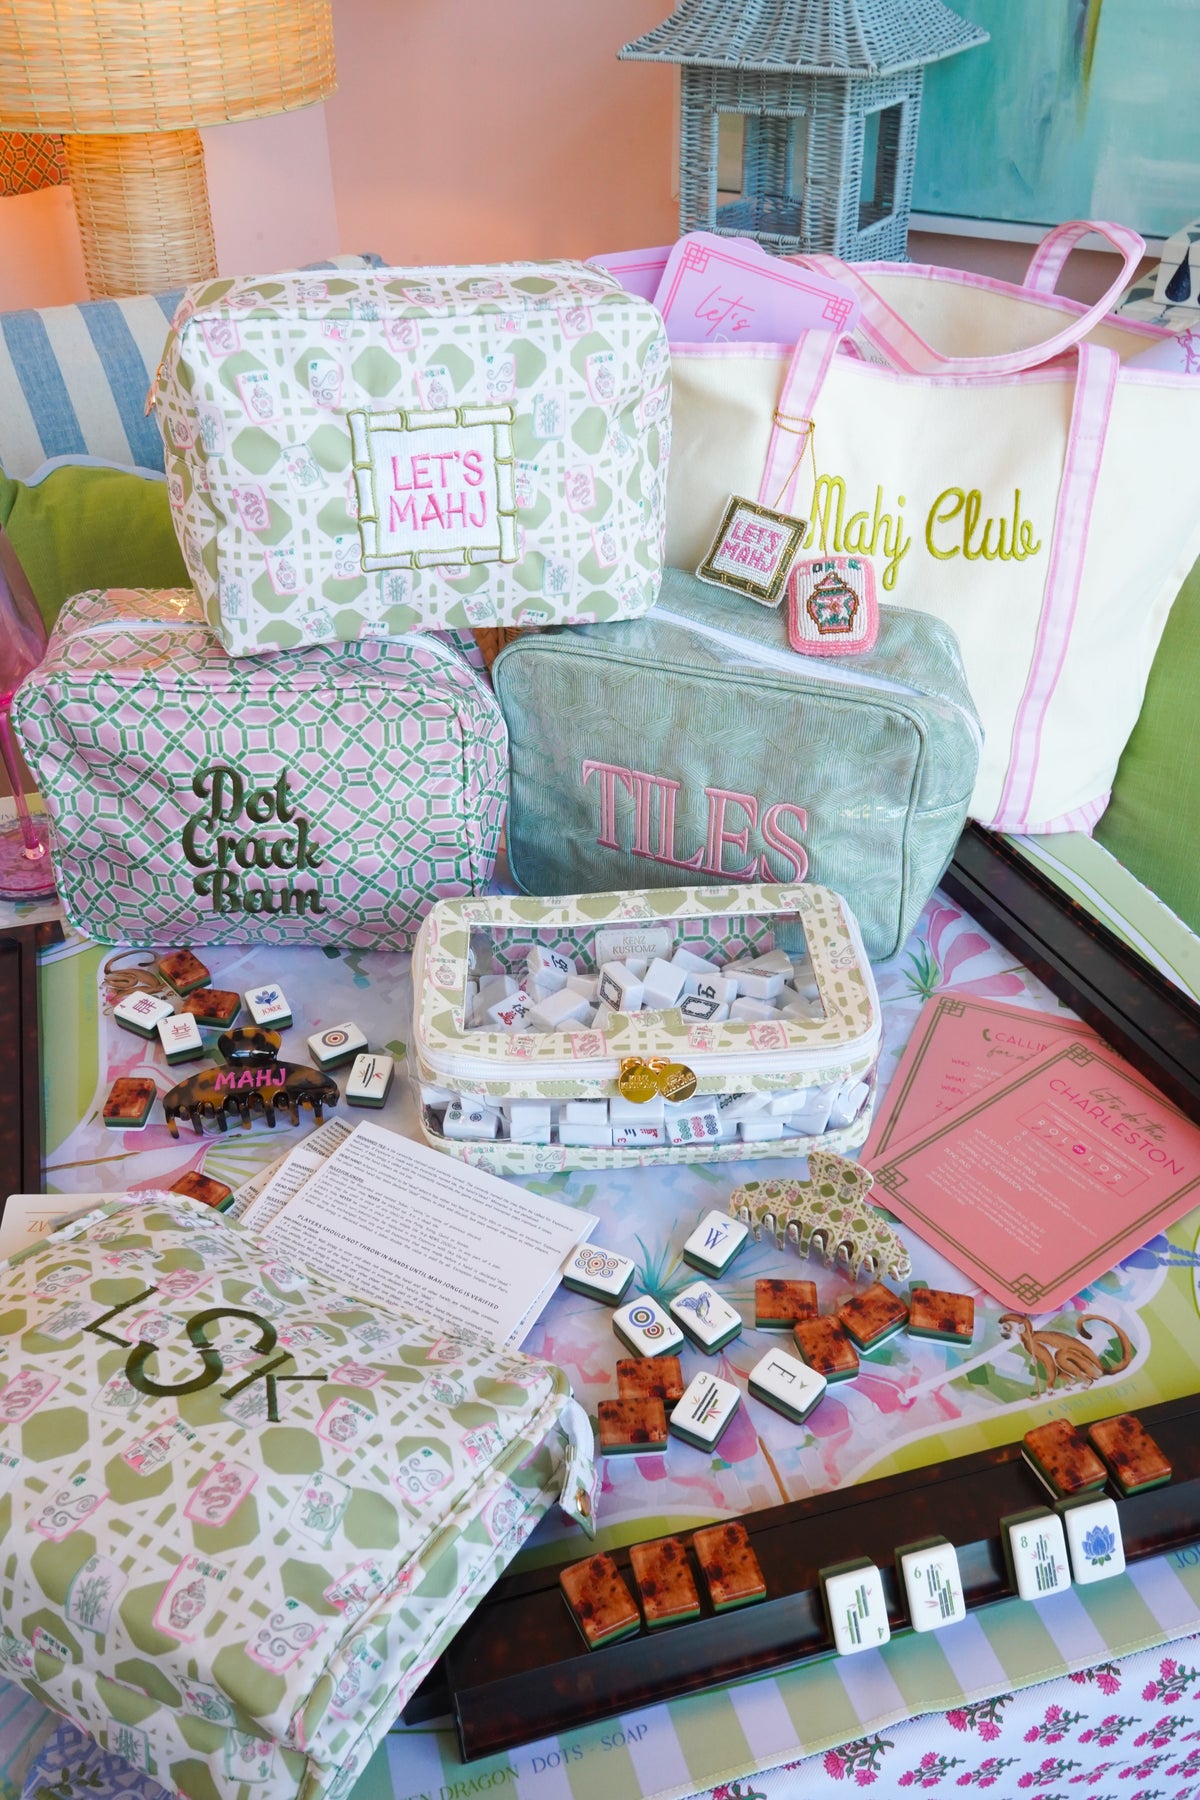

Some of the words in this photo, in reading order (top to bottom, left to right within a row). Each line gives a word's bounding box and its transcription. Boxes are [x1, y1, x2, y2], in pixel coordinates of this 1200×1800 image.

[694, 285, 756, 337] let's
[391, 450, 485, 491] LET'S
[389, 491, 487, 533] MAHJ
[731, 520, 783, 554] LET'S
[802, 474, 912, 592] Mahj
[926, 487, 1042, 561] Club
[720, 540, 777, 574] MAHJ
[192, 765, 296, 823] Dot
[582, 759, 809, 884] TILES
[182, 815, 324, 870] Crack
[193, 869, 328, 915] Bam
[612, 944, 656, 955] KUSTOMZ
[622, 935, 647, 945] KENZ
[262, 1004, 282, 1016] JOKER
[214, 1068, 287, 1092] MAHJ
[1049, 1079, 1185, 1177] CHARLESTON
[703, 1226, 729, 1250] W
[296, 1214, 322, 1228] PLAYERS
[321, 1226, 346, 1239] SHOULD
[345, 1236, 358, 1245] NOT
[358, 1243, 381, 1256] THROW
[387, 1256, 409, 1268] HANDS
[408, 1266, 427, 1277] UNTIL
[427, 1274, 442, 1284] MAH
[442, 1281, 464, 1293] JONGG
[470, 1294, 499, 1310] VERIFIED
[766, 1360, 799, 1385] E
[1019, 1535, 1029, 1549] 8
[913, 1565, 923, 1580] 6
[438, 1764, 520, 1800] DRAGON
[531, 1744, 585, 1775] DOTS
[600, 1723, 650, 1752] SOAP
